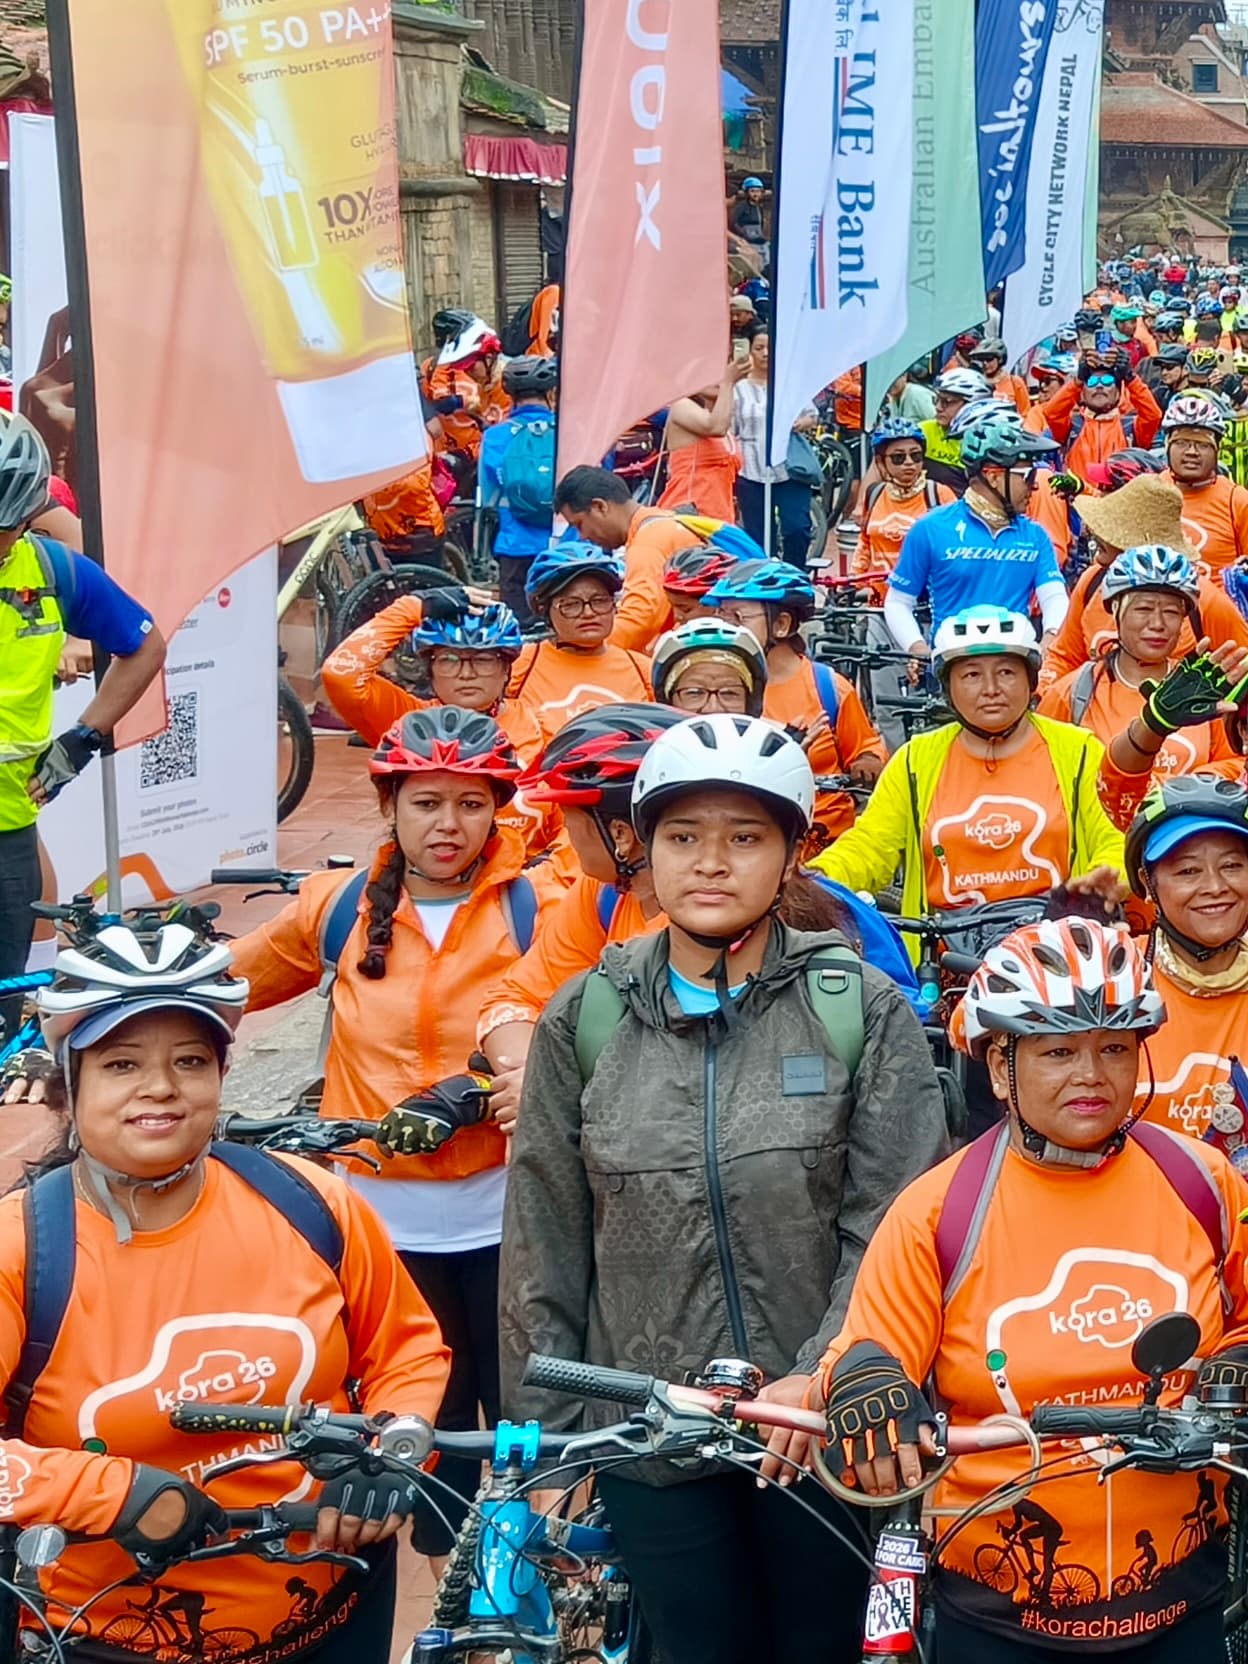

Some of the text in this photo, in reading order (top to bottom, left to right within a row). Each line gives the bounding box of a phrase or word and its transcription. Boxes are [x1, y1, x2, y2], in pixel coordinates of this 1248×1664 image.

[204, 24, 249, 66] SPF
[261, 16, 310, 53] 50
[837, 49, 876, 157] IME
[1038, 53, 1077, 308] CYCLE CITY NETWORK NEPAL
[910, 116, 935, 297] Australian
[837, 178, 880, 310] Bank
[943, 547, 1039, 562] SPECIALIZED
[965, 820, 1021, 838] kora 26
[954, 867, 1039, 887] KATHMANDU
[1168, 1099, 1212, 1121] kora
[1049, 1299, 1153, 1334] kora 26
[154, 1354, 277, 1413] kora 26
[1021, 1600, 1188, 1639] #korachallenge
